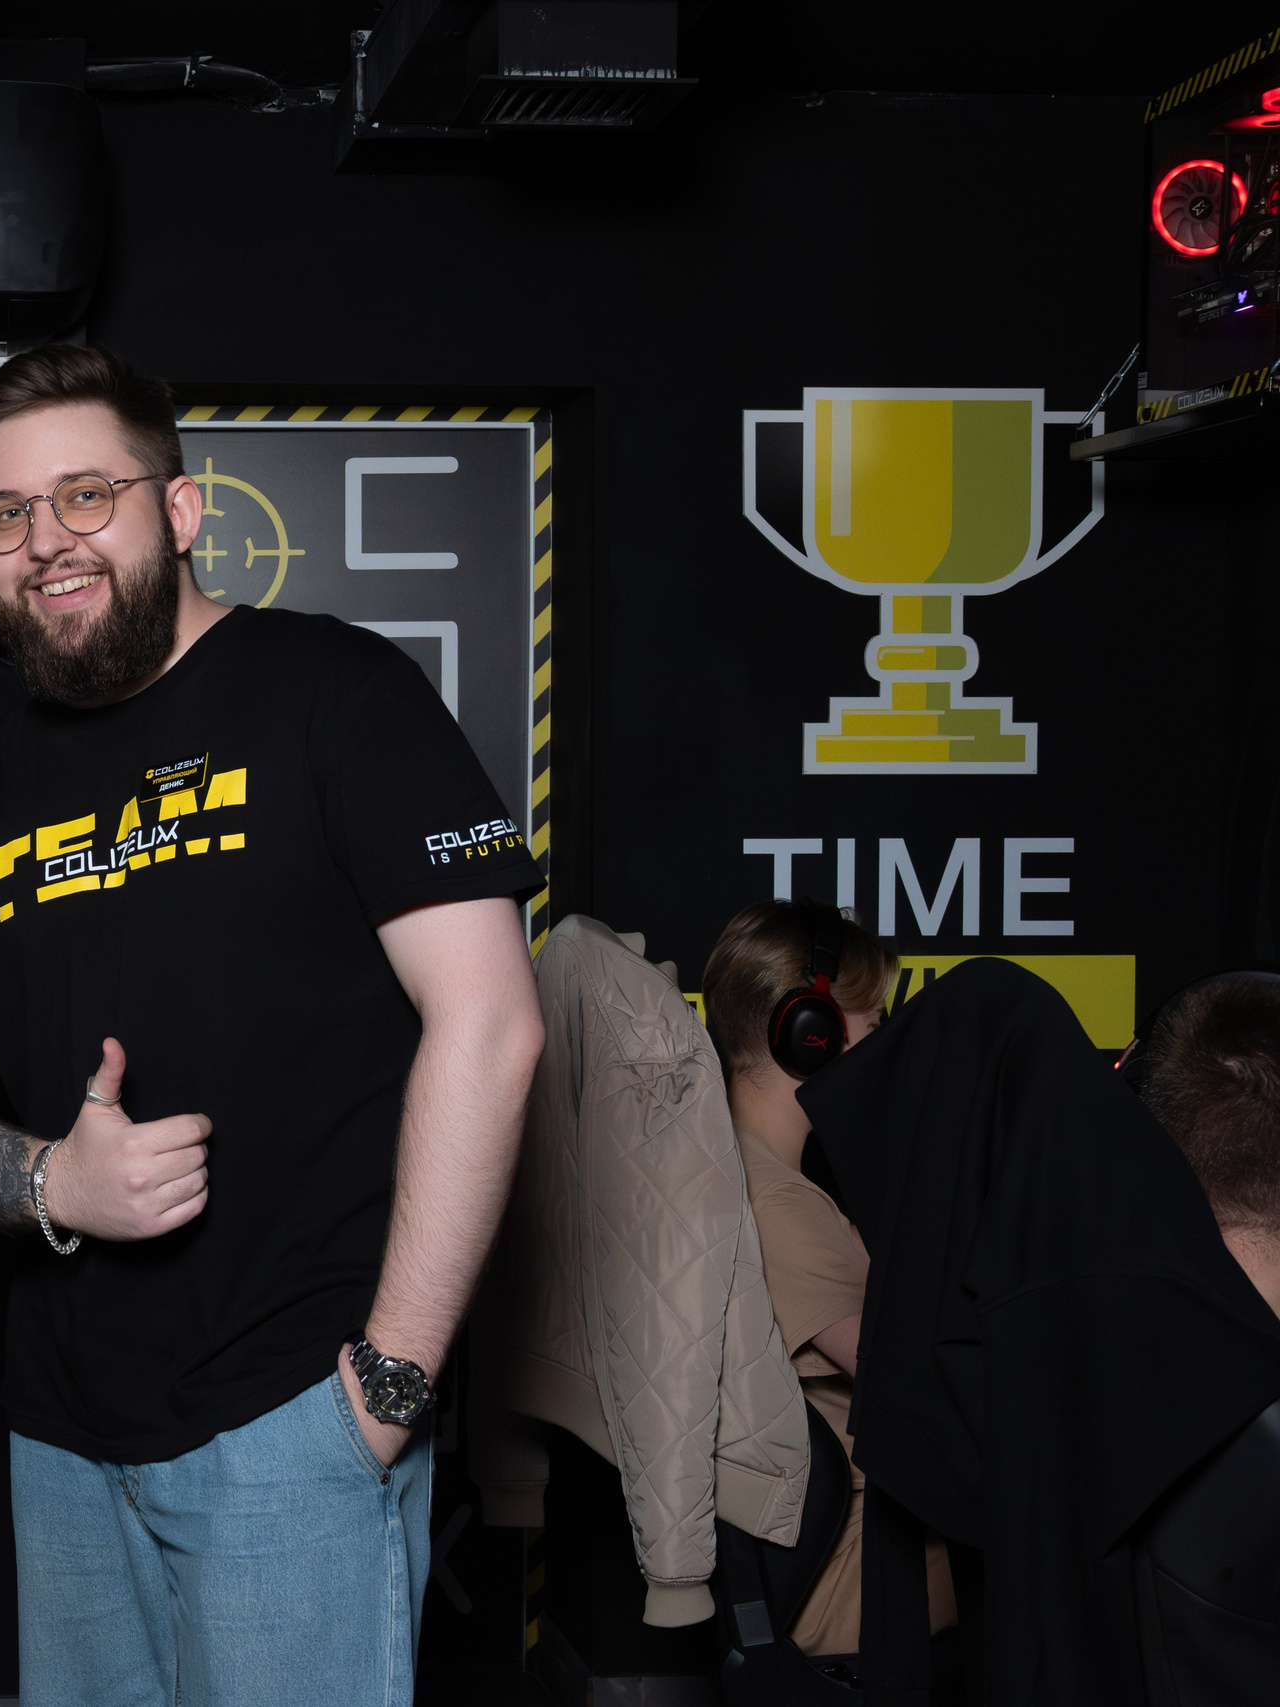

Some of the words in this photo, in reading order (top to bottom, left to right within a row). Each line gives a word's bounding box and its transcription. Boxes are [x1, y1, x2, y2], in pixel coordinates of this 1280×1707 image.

[1177, 385, 1225, 410] COLIZEUM
[152, 766, 198, 785] УПРАВЛЯЮЩИЙ
[155, 756, 205, 776] COLIZEUM
[159, 779, 185, 793] ДЕНИС
[44, 820, 179, 881] COLIZEUM
[430, 852, 451, 865] IS
[742, 837, 1075, 936] TIME
